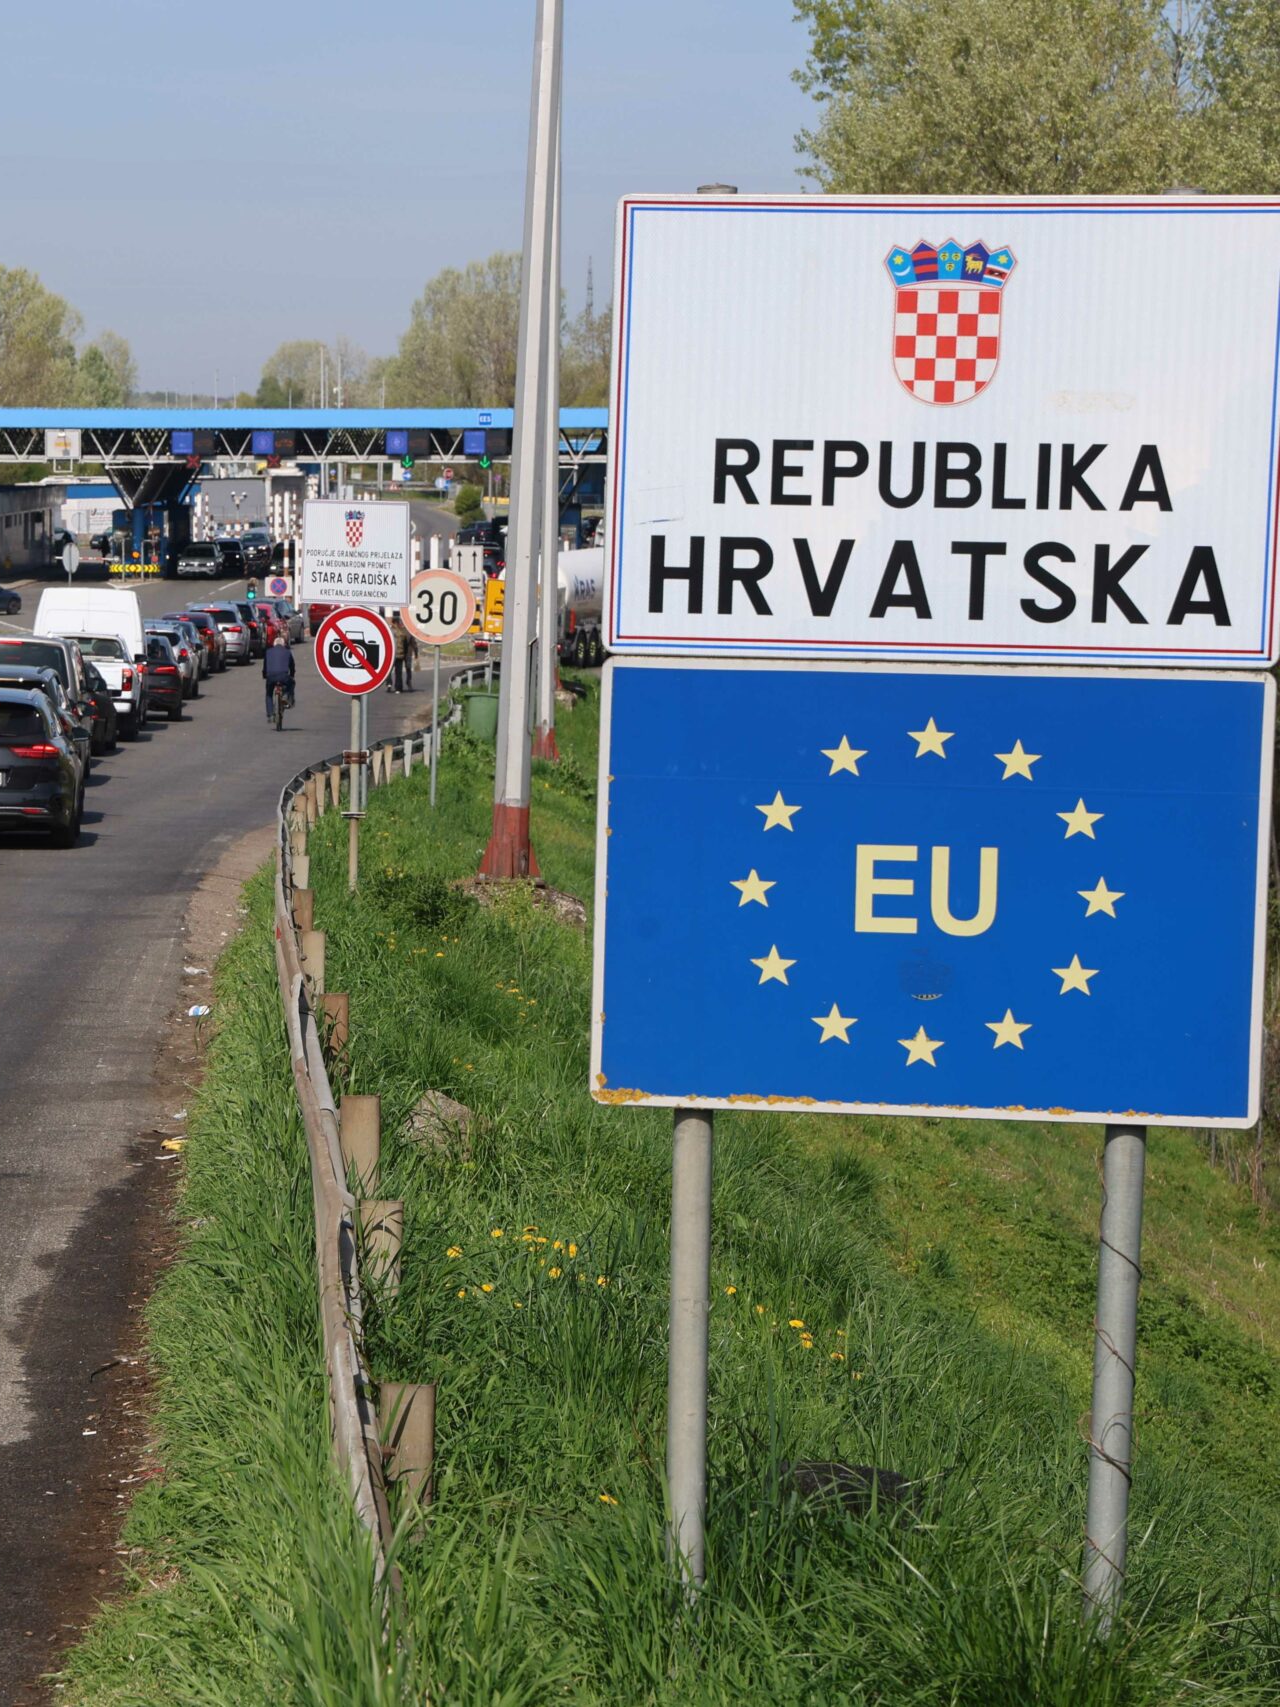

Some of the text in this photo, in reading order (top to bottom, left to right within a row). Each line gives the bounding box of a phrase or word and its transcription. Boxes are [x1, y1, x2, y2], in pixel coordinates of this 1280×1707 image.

[713, 438, 1173, 512] REPUBLIKA
[306, 549, 403, 560] PODRUČJE GRANIČNOG PRIJELAZA
[316, 559, 324, 567] ZA
[368, 561, 391, 570] PROMET
[311, 571, 397, 586] STARA GRADIŠKA
[648, 535, 1232, 627] HRVATSKA
[320, 588, 388, 598] KRETANJE OGRANIČENO
[415, 589, 458, 626] 30
[854, 844, 999, 937] EU
